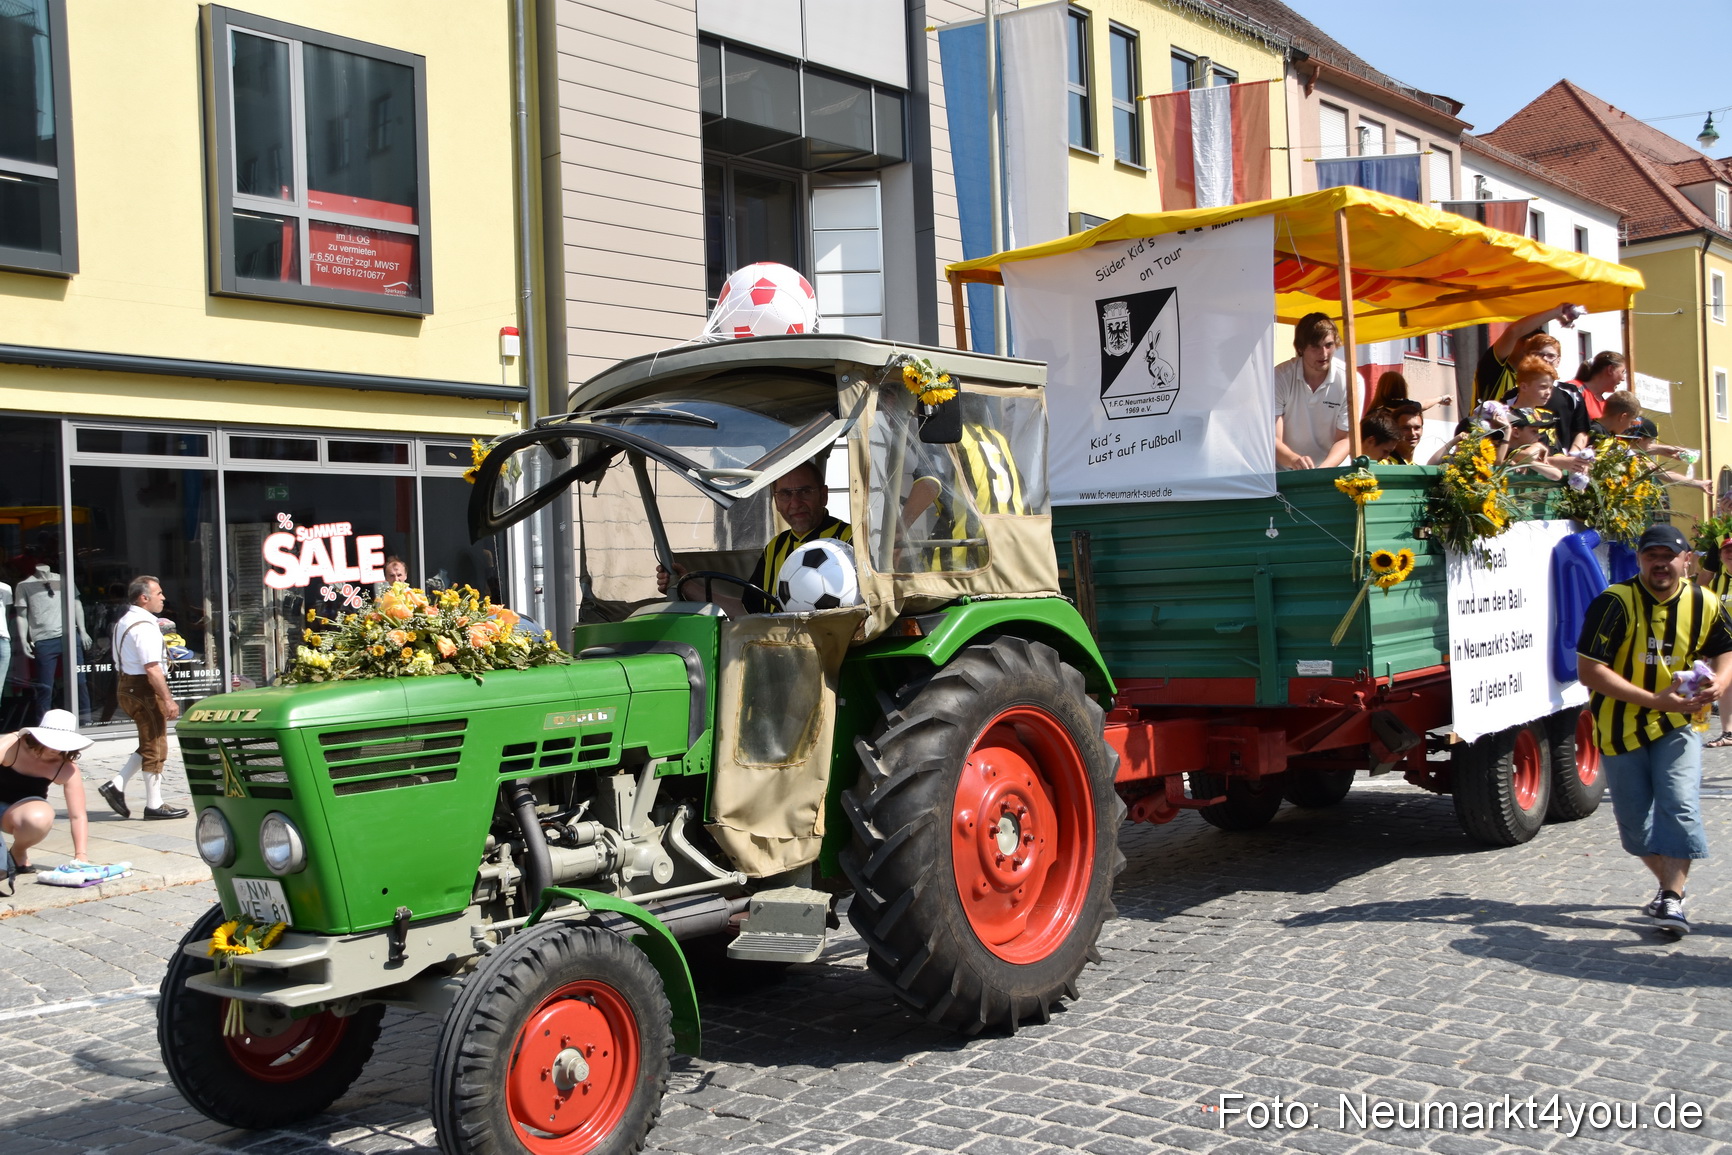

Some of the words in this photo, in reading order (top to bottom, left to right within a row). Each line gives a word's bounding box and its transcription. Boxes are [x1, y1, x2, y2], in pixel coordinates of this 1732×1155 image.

[336, 232, 346, 241] im
[356, 234, 371, 244] OG
[328, 243, 338, 251] zu
[339, 245, 377, 256] vermieten
[316, 263, 330, 273] Tel.
[332, 266, 386, 280] 09181/210677
[355, 258, 373, 269] zzgl.
[374, 261, 400, 271] MWST
[1095, 256, 1126, 282] Süder
[1139, 267, 1154, 281] on
[1153, 247, 1182, 270] Tour
[1088, 449, 1114, 466] Lust
[1117, 441, 1137, 458] auf
[1140, 429, 1182, 452] Fußball
[1079, 487, 1173, 500] www.fc-neumarkt-sued.de
[296, 521, 353, 542] SUMMER
[263, 531, 387, 590] SALE
[1457, 592, 1476, 616] rund
[1477, 596, 1491, 613] um
[1492, 590, 1507, 611] den
[1508, 588, 1523, 610] Ball
[1454, 639, 1462, 662] in
[1463, 632, 1510, 660] Neumarkt's
[1510, 629, 1534, 652] Süden
[76, 664, 92, 673] SEE
[95, 663, 112, 672] THE
[174, 670, 191, 679] THE
[193, 668, 221, 679] WORLD
[1469, 680, 1483, 704] auf
[1485, 676, 1508, 707] jeden
[1508, 671, 1523, 695] Fall
[189, 708, 262, 723] DEUTZ
[245, 880, 272, 900] NM
